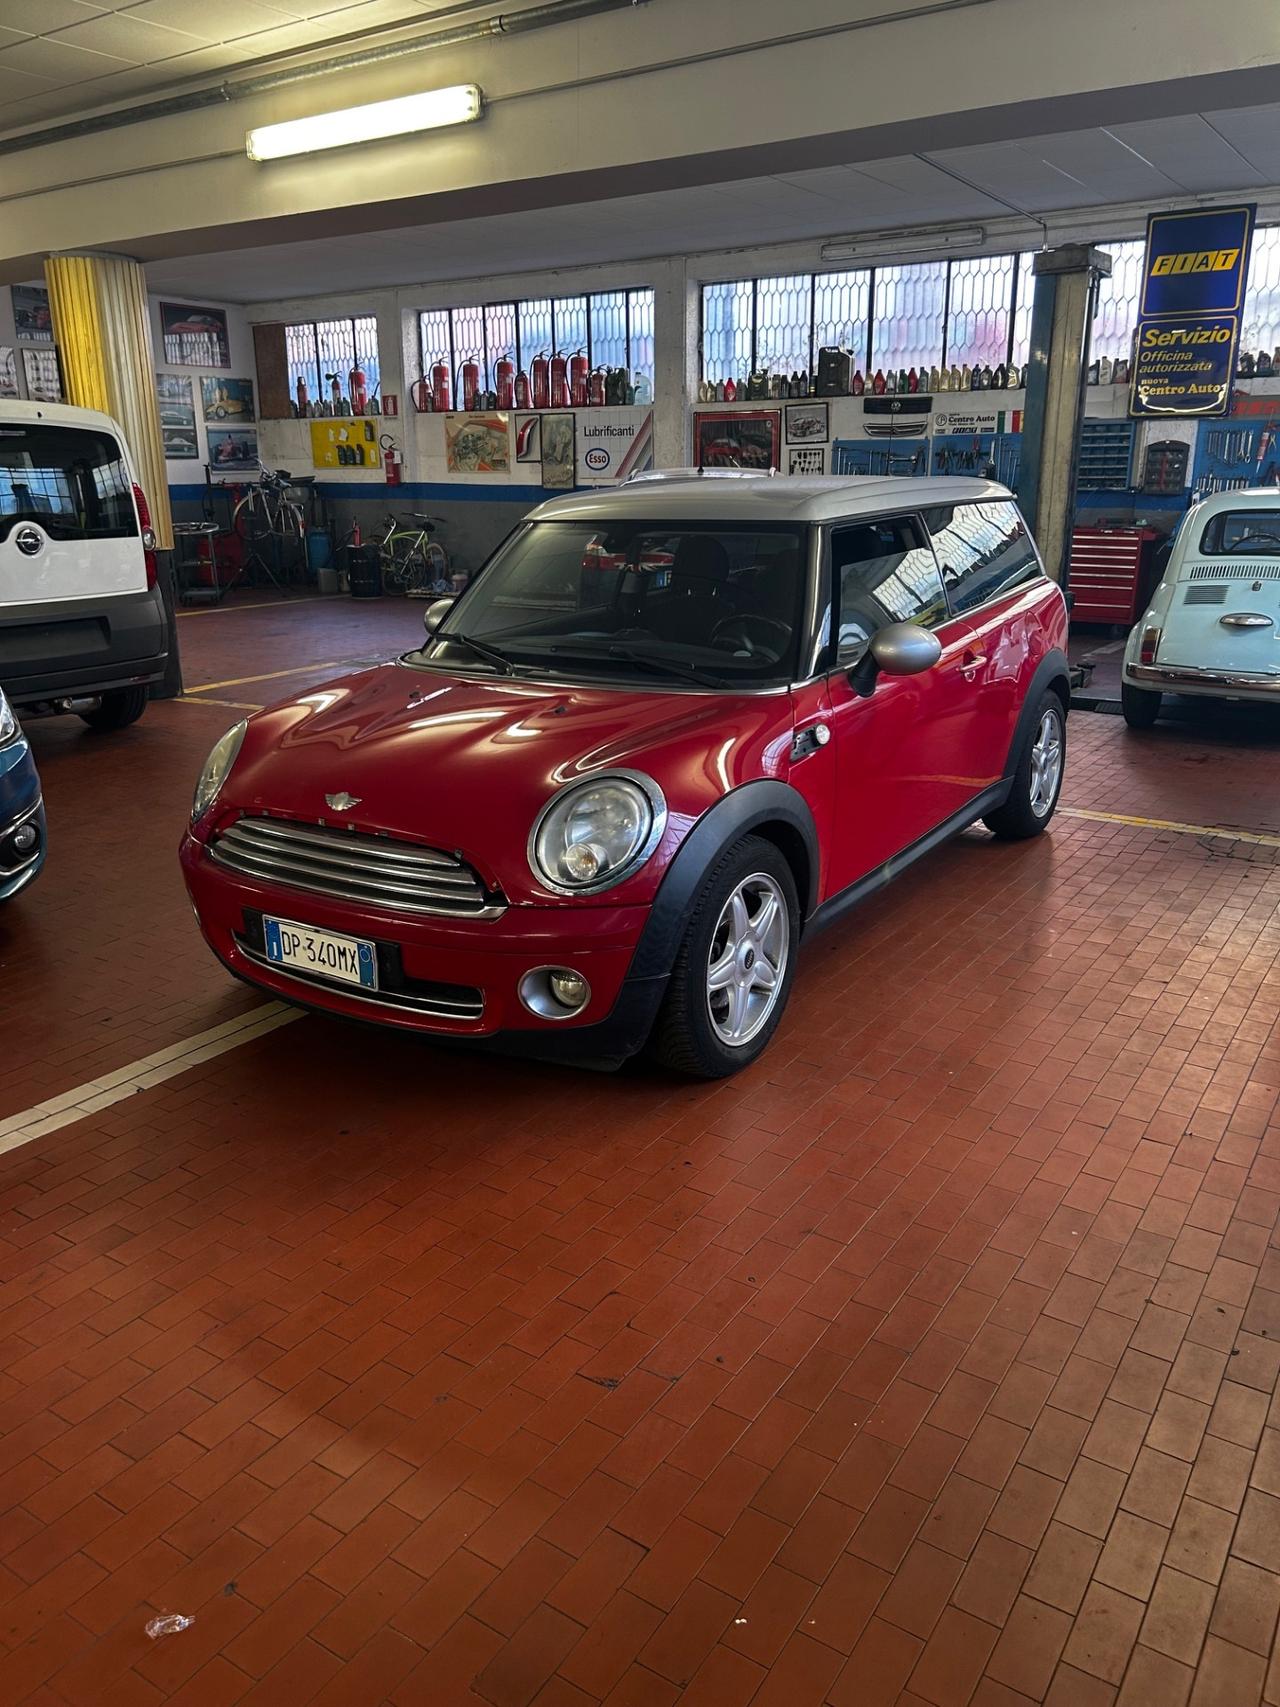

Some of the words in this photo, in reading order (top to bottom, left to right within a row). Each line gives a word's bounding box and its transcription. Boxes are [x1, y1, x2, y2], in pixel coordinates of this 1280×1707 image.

[1154, 251, 1236, 273] FIAT
[1142, 325, 1230, 347] Servizio
[1140, 350, 1192, 362] Officina
[1141, 385, 1185, 396] Centro
[1187, 383, 1220, 394] Auto
[584, 425, 634, 437] Lubrificanti
[589, 454, 606, 463] Esso
[281, 931, 300, 957] DP
[305, 937, 358, 975] 340MX
